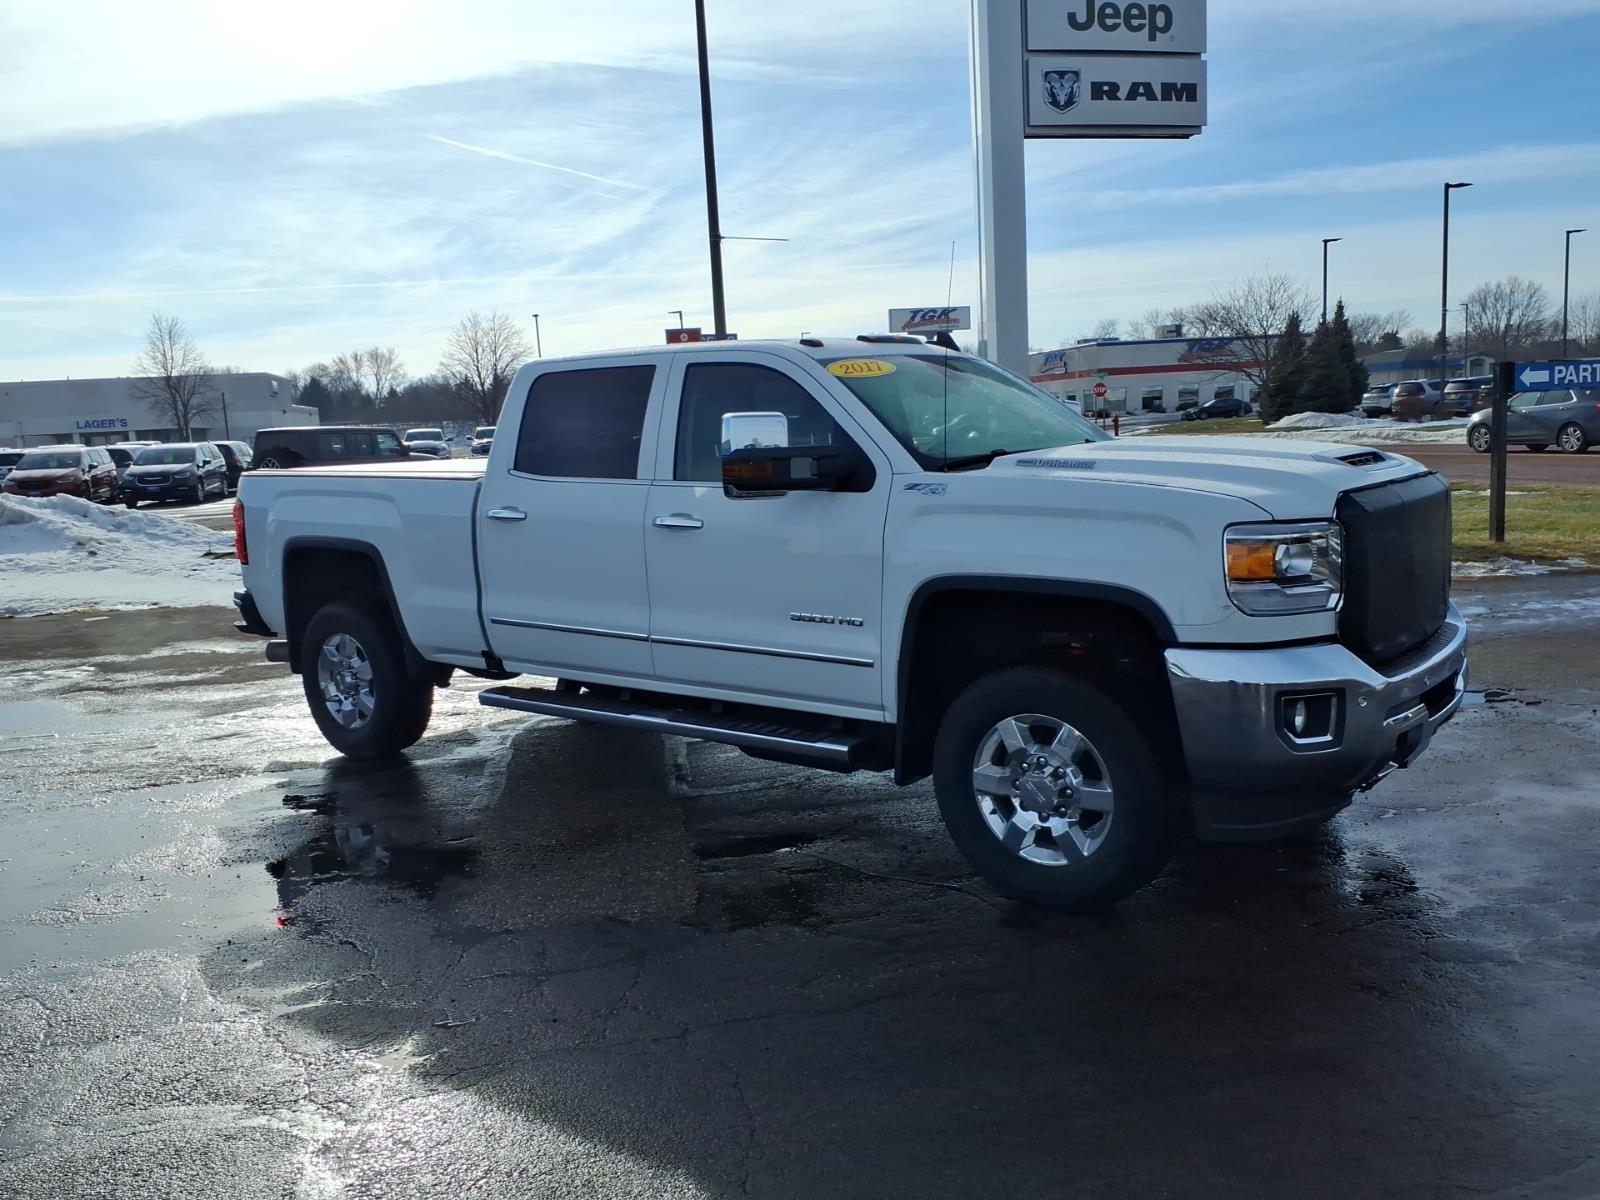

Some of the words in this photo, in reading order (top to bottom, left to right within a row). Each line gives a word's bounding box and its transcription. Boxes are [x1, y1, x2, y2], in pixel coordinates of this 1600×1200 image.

[1066, 0, 1173, 42] Jeep
[1090, 81, 1198, 103] RAM
[908, 308, 957, 322] TGK
[839, 361, 882, 375] 2017
[76, 418, 128, 429] LAGER'S
[838, 616, 863, 627] HD
